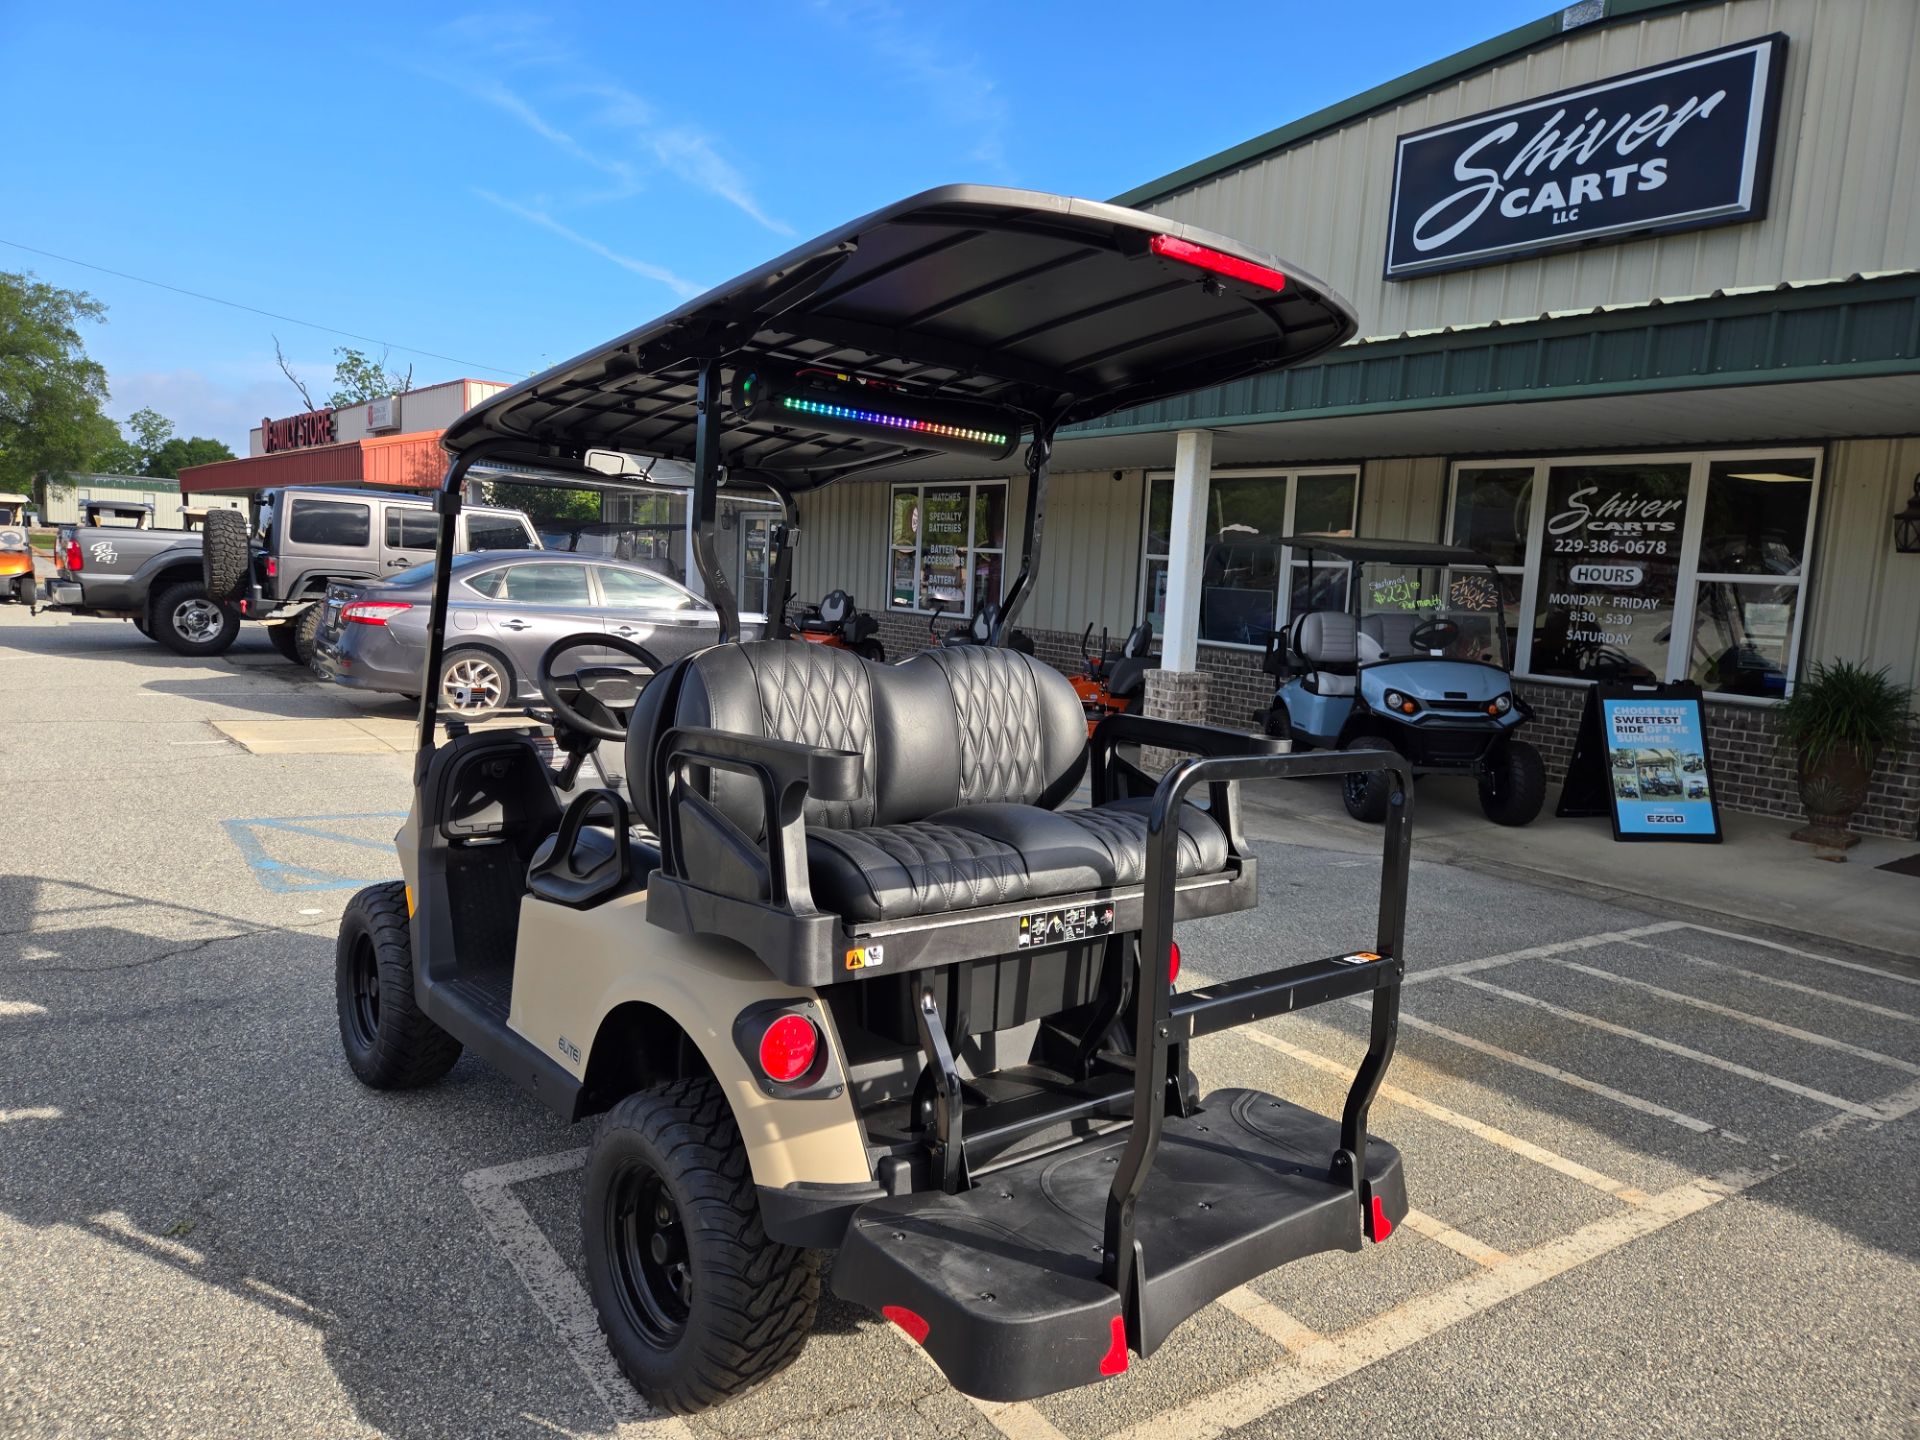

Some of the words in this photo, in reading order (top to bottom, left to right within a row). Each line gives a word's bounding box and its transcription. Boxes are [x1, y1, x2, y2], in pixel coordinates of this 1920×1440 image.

[1412, 90, 1727, 252] Shiver
[1499, 158, 1668, 218] CARTS
[1552, 207, 1579, 225] LLC
[298, 408, 334, 447] STORE
[932, 492, 961, 502] WATCHES
[929, 512, 962, 521] SPECIALTY
[1548, 486, 1682, 535] Shiver
[928, 523, 962, 533] BATTERIES
[1587, 522, 1676, 531] CARTS
[930, 544, 957, 554] BATTERY
[1554, 539, 1667, 555] 229-386-0678
[928, 574, 956, 585] BATTERY
[1577, 567, 1635, 583] HOURS
[1549, 593, 1604, 606] MONDAY
[1613, 597, 1660, 610] FRIDAY
[1569, 611, 1596, 622] 8:30
[1605, 613, 1633, 625] 5:30
[1566, 630, 1632, 645] SATURDAY
[1614, 707, 1661, 715] CHOOSE
[1663, 707, 1687, 715] THE
[1615, 716, 1679, 724] SWEETEST
[1646, 726, 1661, 734] OF
[1665, 726, 1689, 734] THE
